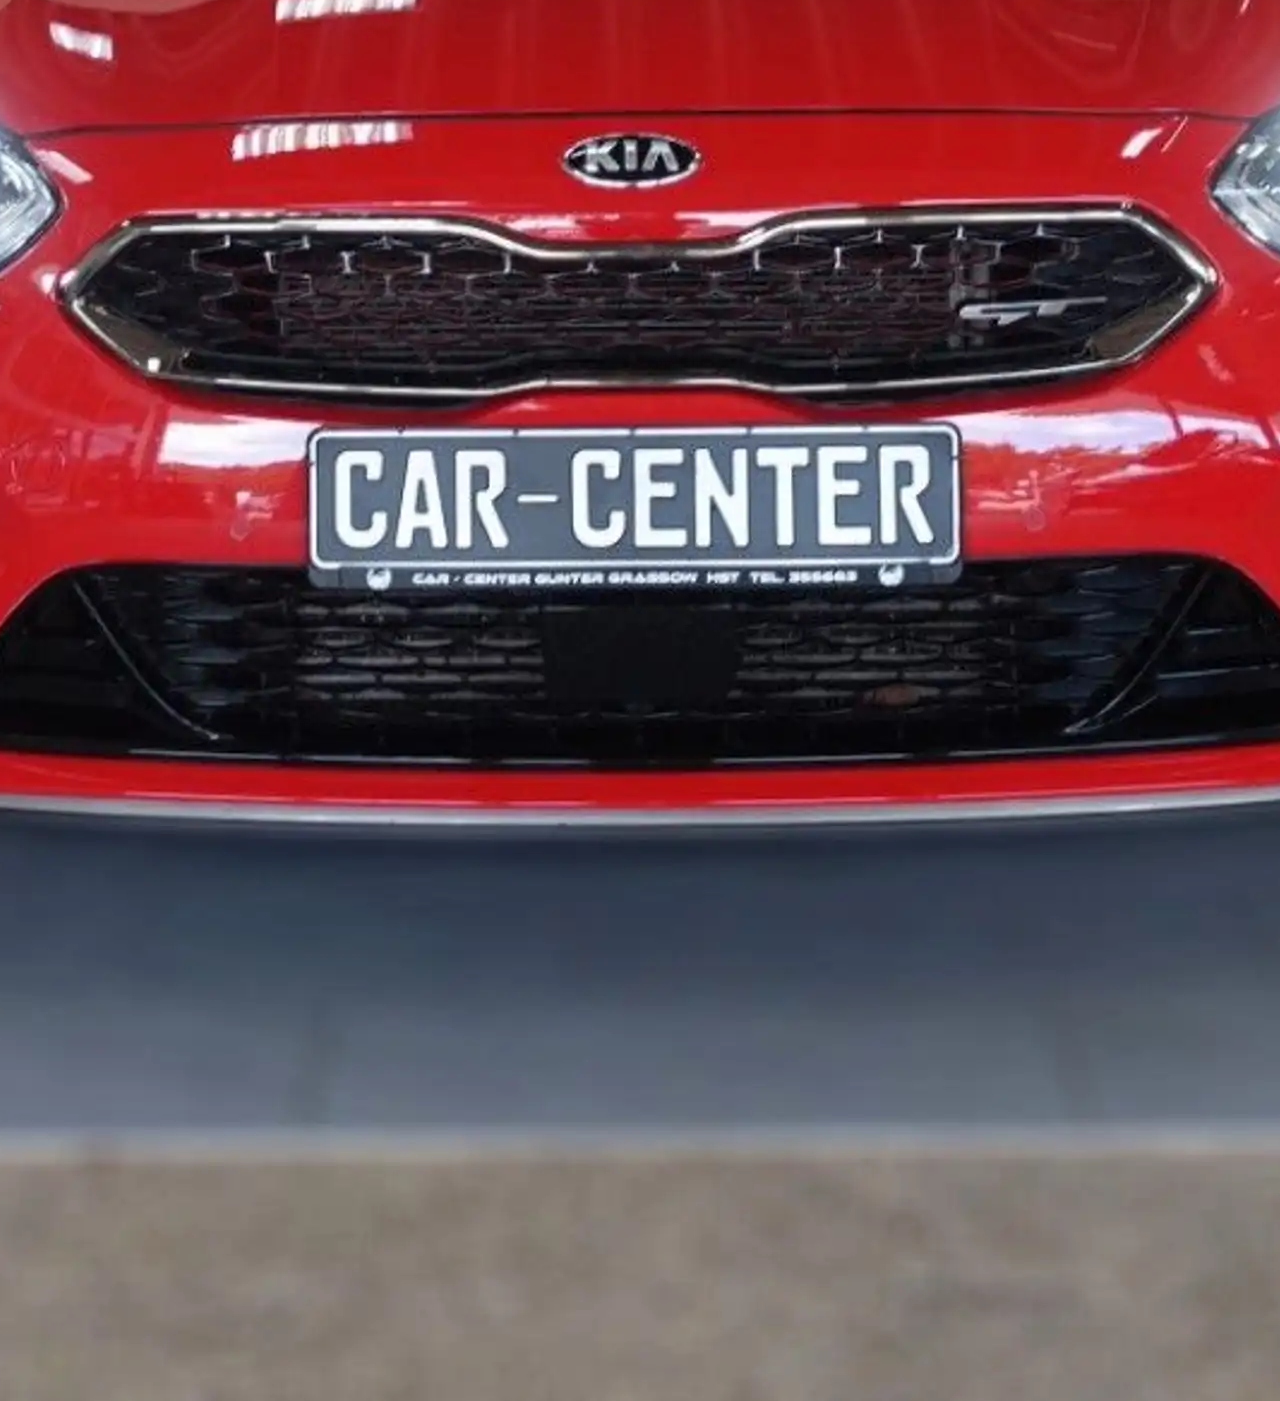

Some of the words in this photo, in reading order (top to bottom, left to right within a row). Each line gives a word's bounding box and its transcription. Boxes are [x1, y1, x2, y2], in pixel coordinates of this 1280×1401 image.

[584, 139, 680, 173] KIA
[959, 296, 1108, 326] GT
[412, 572, 450, 585] CAR
[463, 572, 531, 585] CENTER
